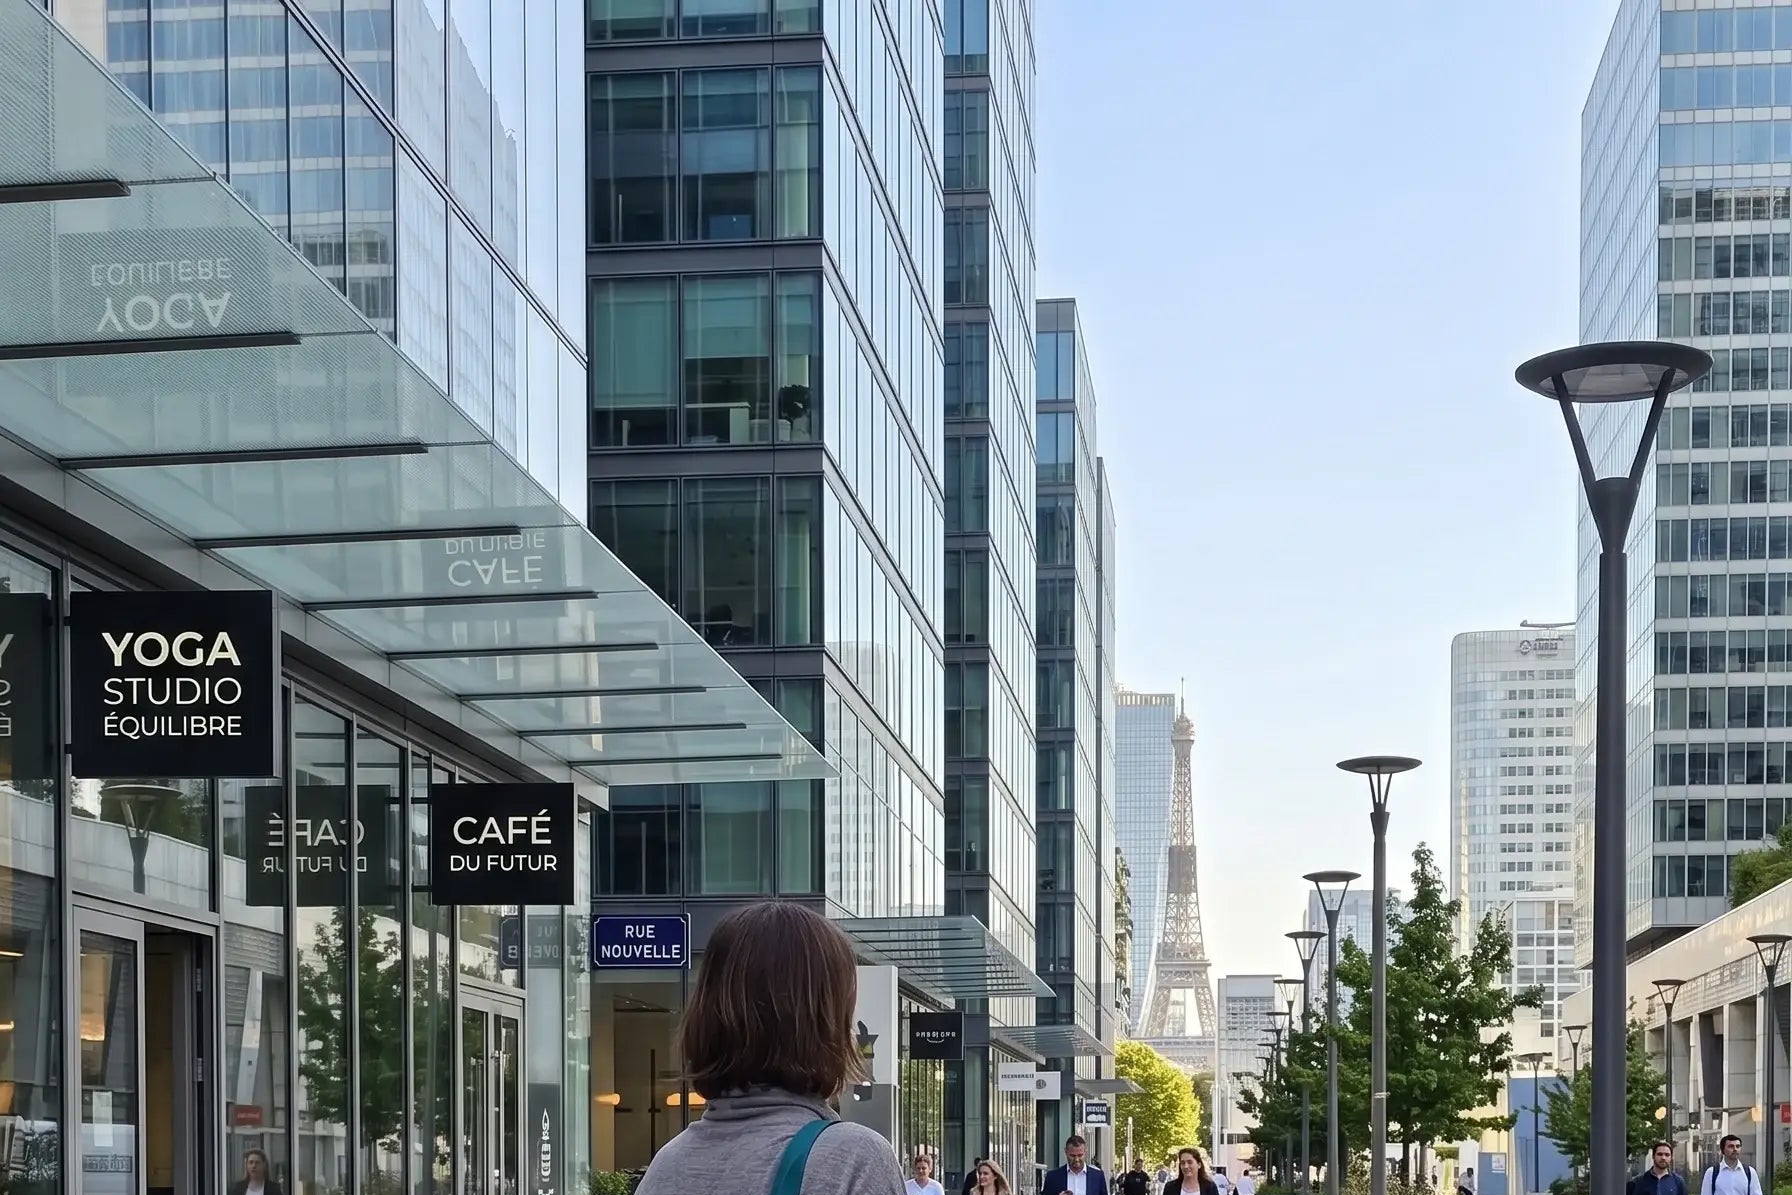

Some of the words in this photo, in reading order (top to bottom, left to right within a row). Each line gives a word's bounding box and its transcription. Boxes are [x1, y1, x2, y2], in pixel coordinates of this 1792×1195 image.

[101, 631, 242, 667] YOGA
[103, 677, 242, 705] STUDIO
[103, 711, 242, 740] ÉQUILIBRE
[453, 808, 552, 845] CAFÉ
[450, 854, 480, 872] DU
[487, 854, 558, 872] FUTUR
[625, 924, 656, 939] RUE
[601, 944, 681, 959] NOUVELLE
